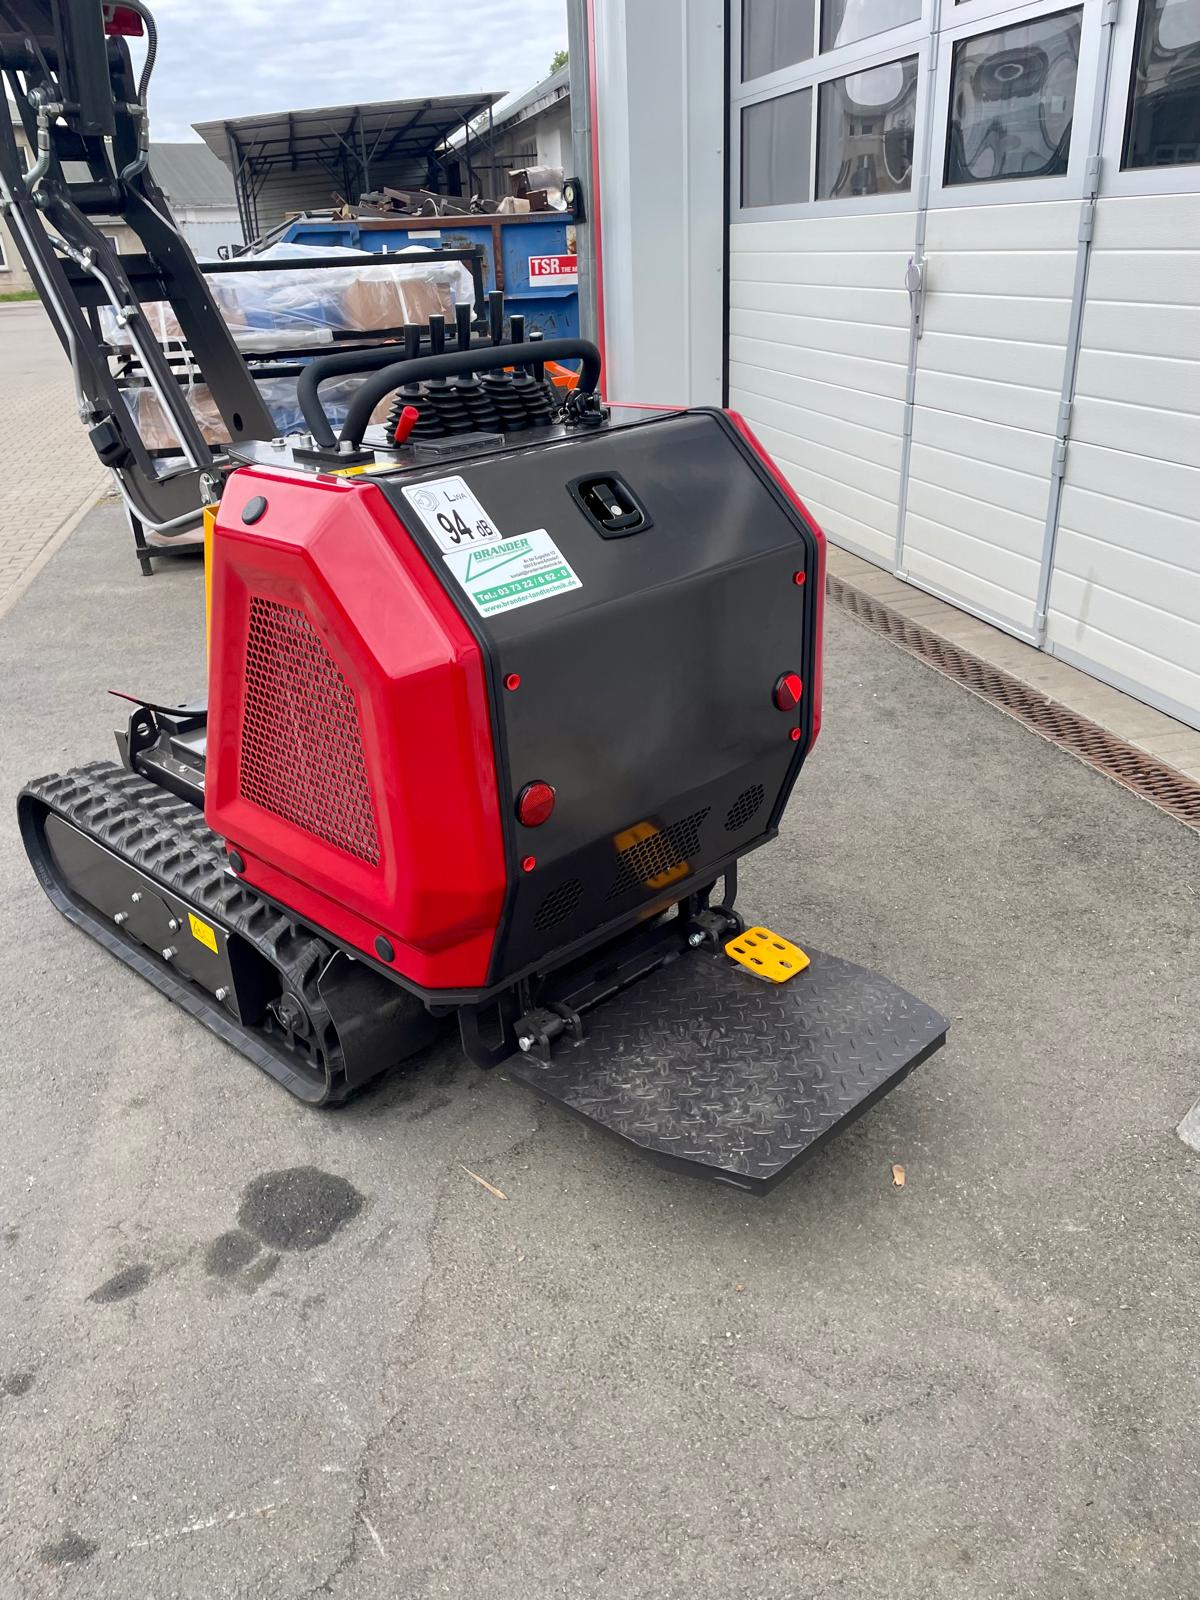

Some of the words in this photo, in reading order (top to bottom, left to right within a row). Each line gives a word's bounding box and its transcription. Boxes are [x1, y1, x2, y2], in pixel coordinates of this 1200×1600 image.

[531, 258, 560, 274] TSR
[436, 509, 475, 544] 94
[476, 519, 494, 537] dB
[473, 538, 529, 560] BRANDER
[478, 590, 497, 602] Tel.:
[497, 587, 510, 596] 03
[510, 583, 522, 592] 73
[521, 580, 534, 589] 22
[482, 580, 577, 613] www.brander-landtechnik.de
